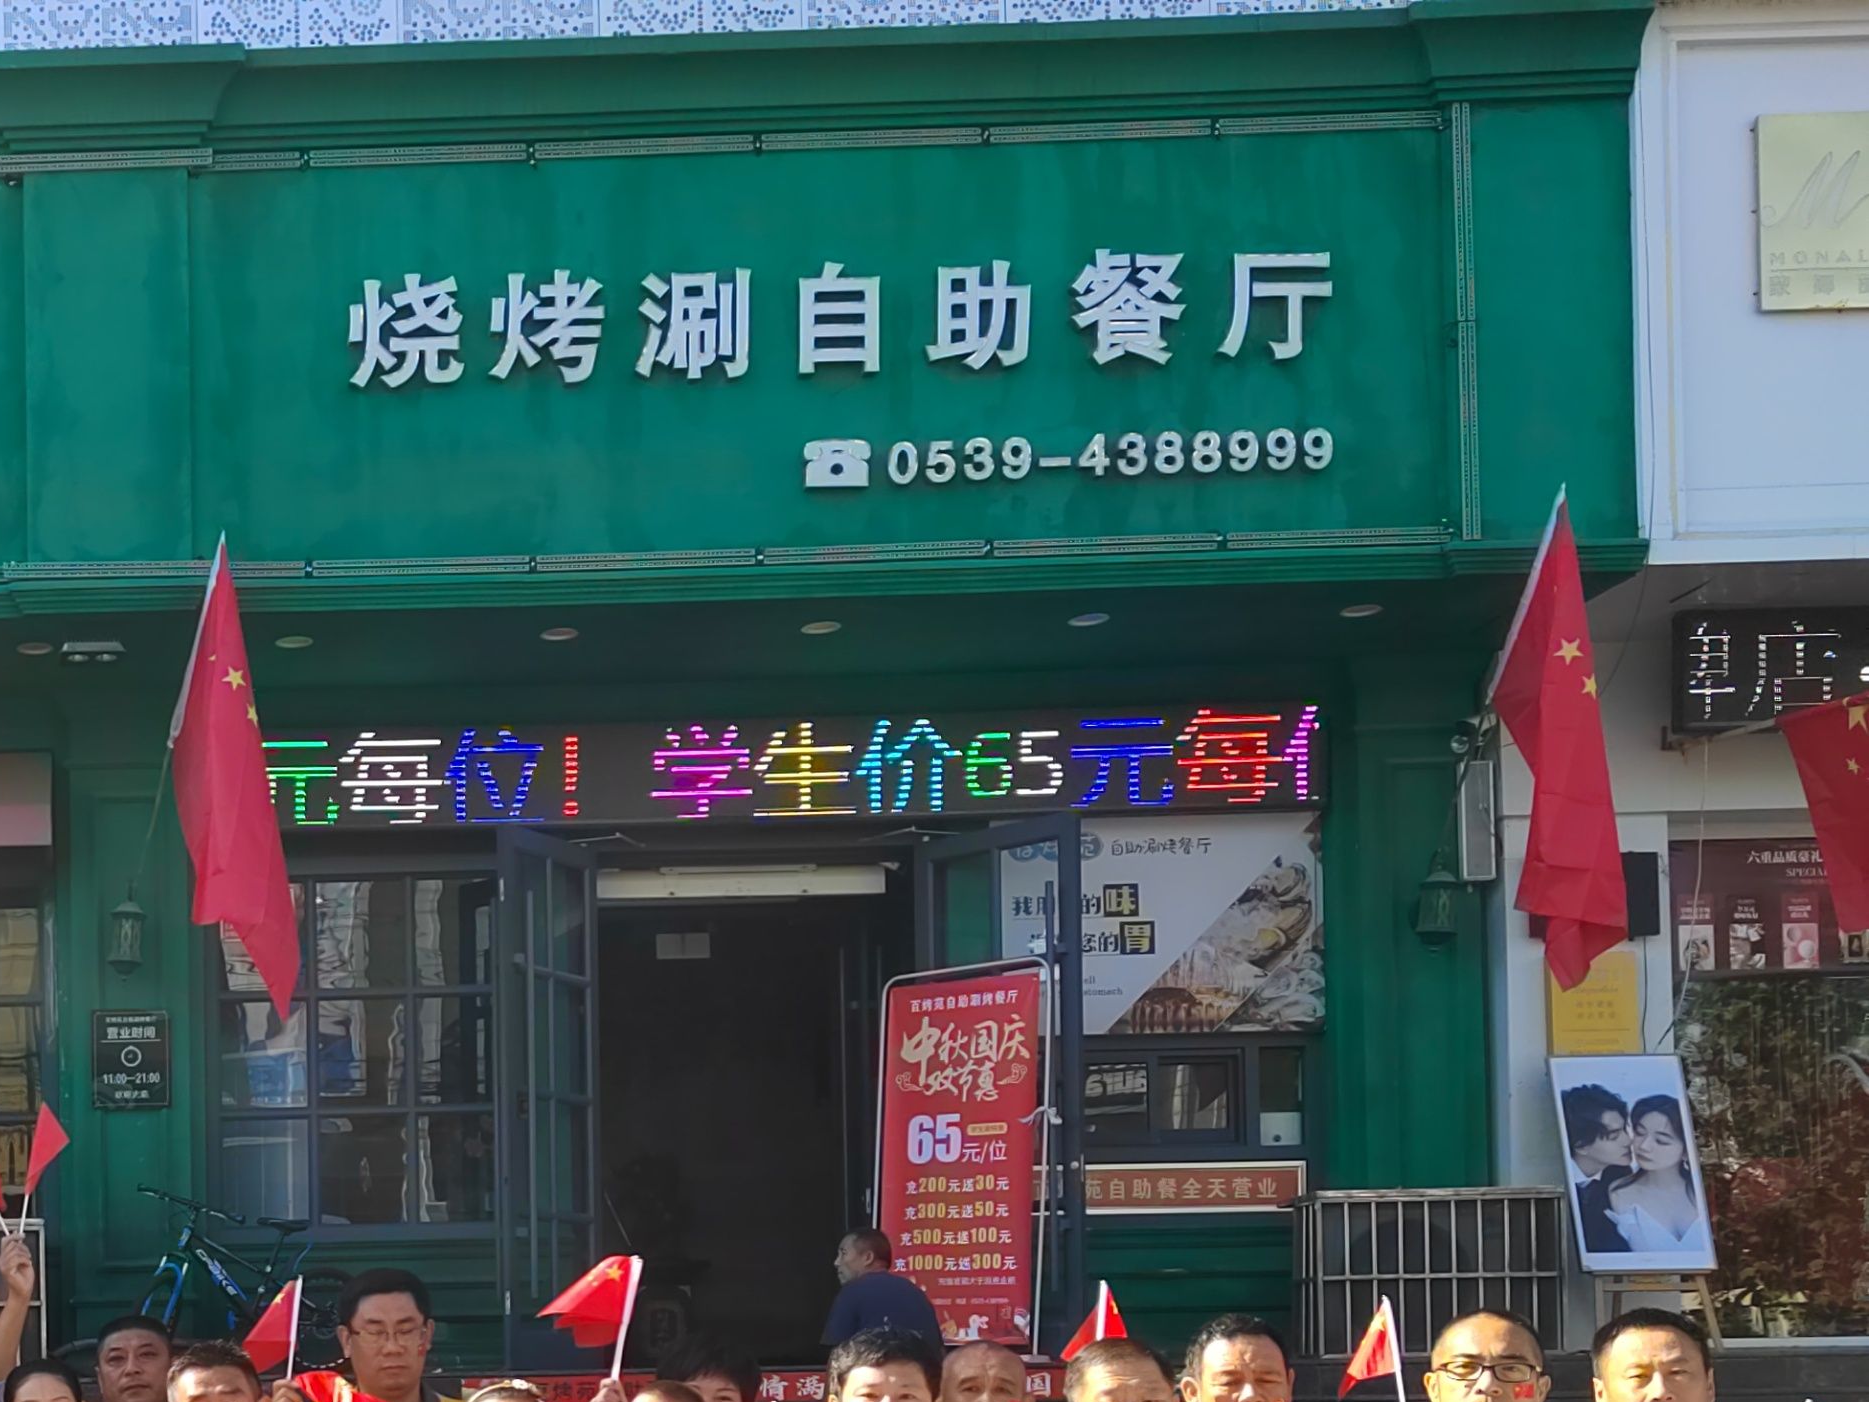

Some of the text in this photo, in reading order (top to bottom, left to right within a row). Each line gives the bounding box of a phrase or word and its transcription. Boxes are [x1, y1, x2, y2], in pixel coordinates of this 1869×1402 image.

[347, 248, 1334, 389] 烧烤涮自助餐厅
[887, 427, 1335, 486] 0539-4388999
[900, 1013, 1030, 1087] 中秋国庆
[1033, 1176, 1278, 1200] 苑自助餐全天营业
